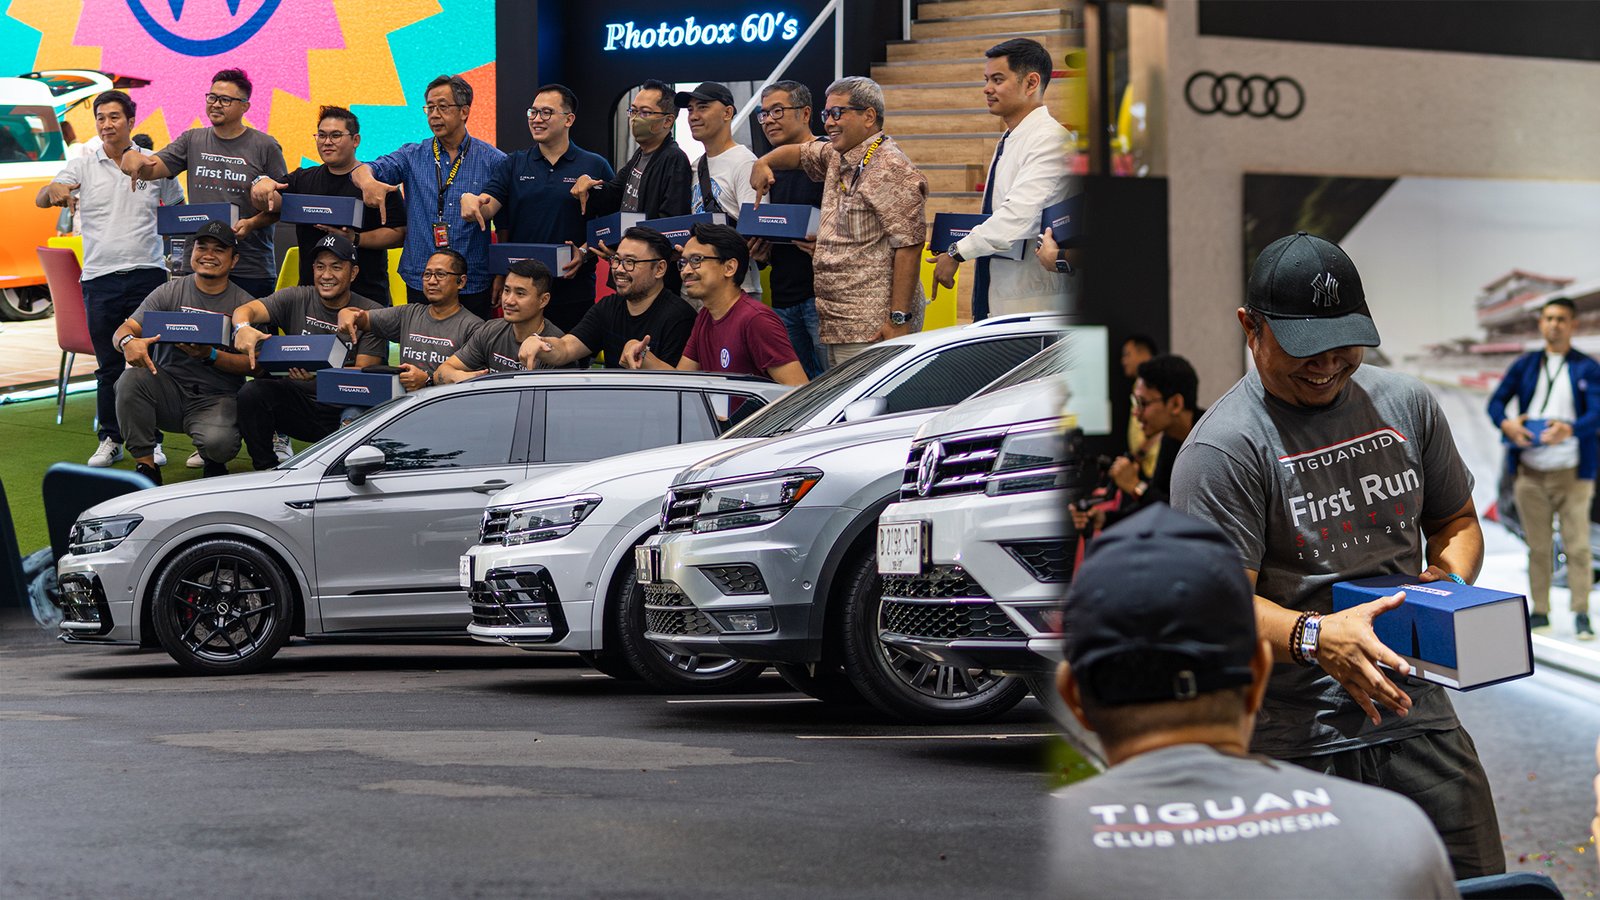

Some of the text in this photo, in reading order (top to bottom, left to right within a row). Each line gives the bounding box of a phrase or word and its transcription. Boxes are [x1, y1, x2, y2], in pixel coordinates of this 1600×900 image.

[603, 12, 798, 50] Photobox 60's
[195, 166, 247, 182] First Run
[201, 155, 243, 165] TIGUAN.ID
[306, 319, 340, 332] TIGUAN
[402, 346, 427, 361] First
[409, 336, 450, 347] TIGUAN.ID
[1284, 435, 1393, 474] TIGUAN.ID
[1288, 468, 1420, 527] First Run
[1296, 502, 1405, 548] SENTU
[1298, 549, 1320, 560] 13
[1331, 534, 1371, 552] July
[1089, 787, 1332, 825] TIGUAN
[1093, 811, 1341, 848] CLUB INDONESIA
